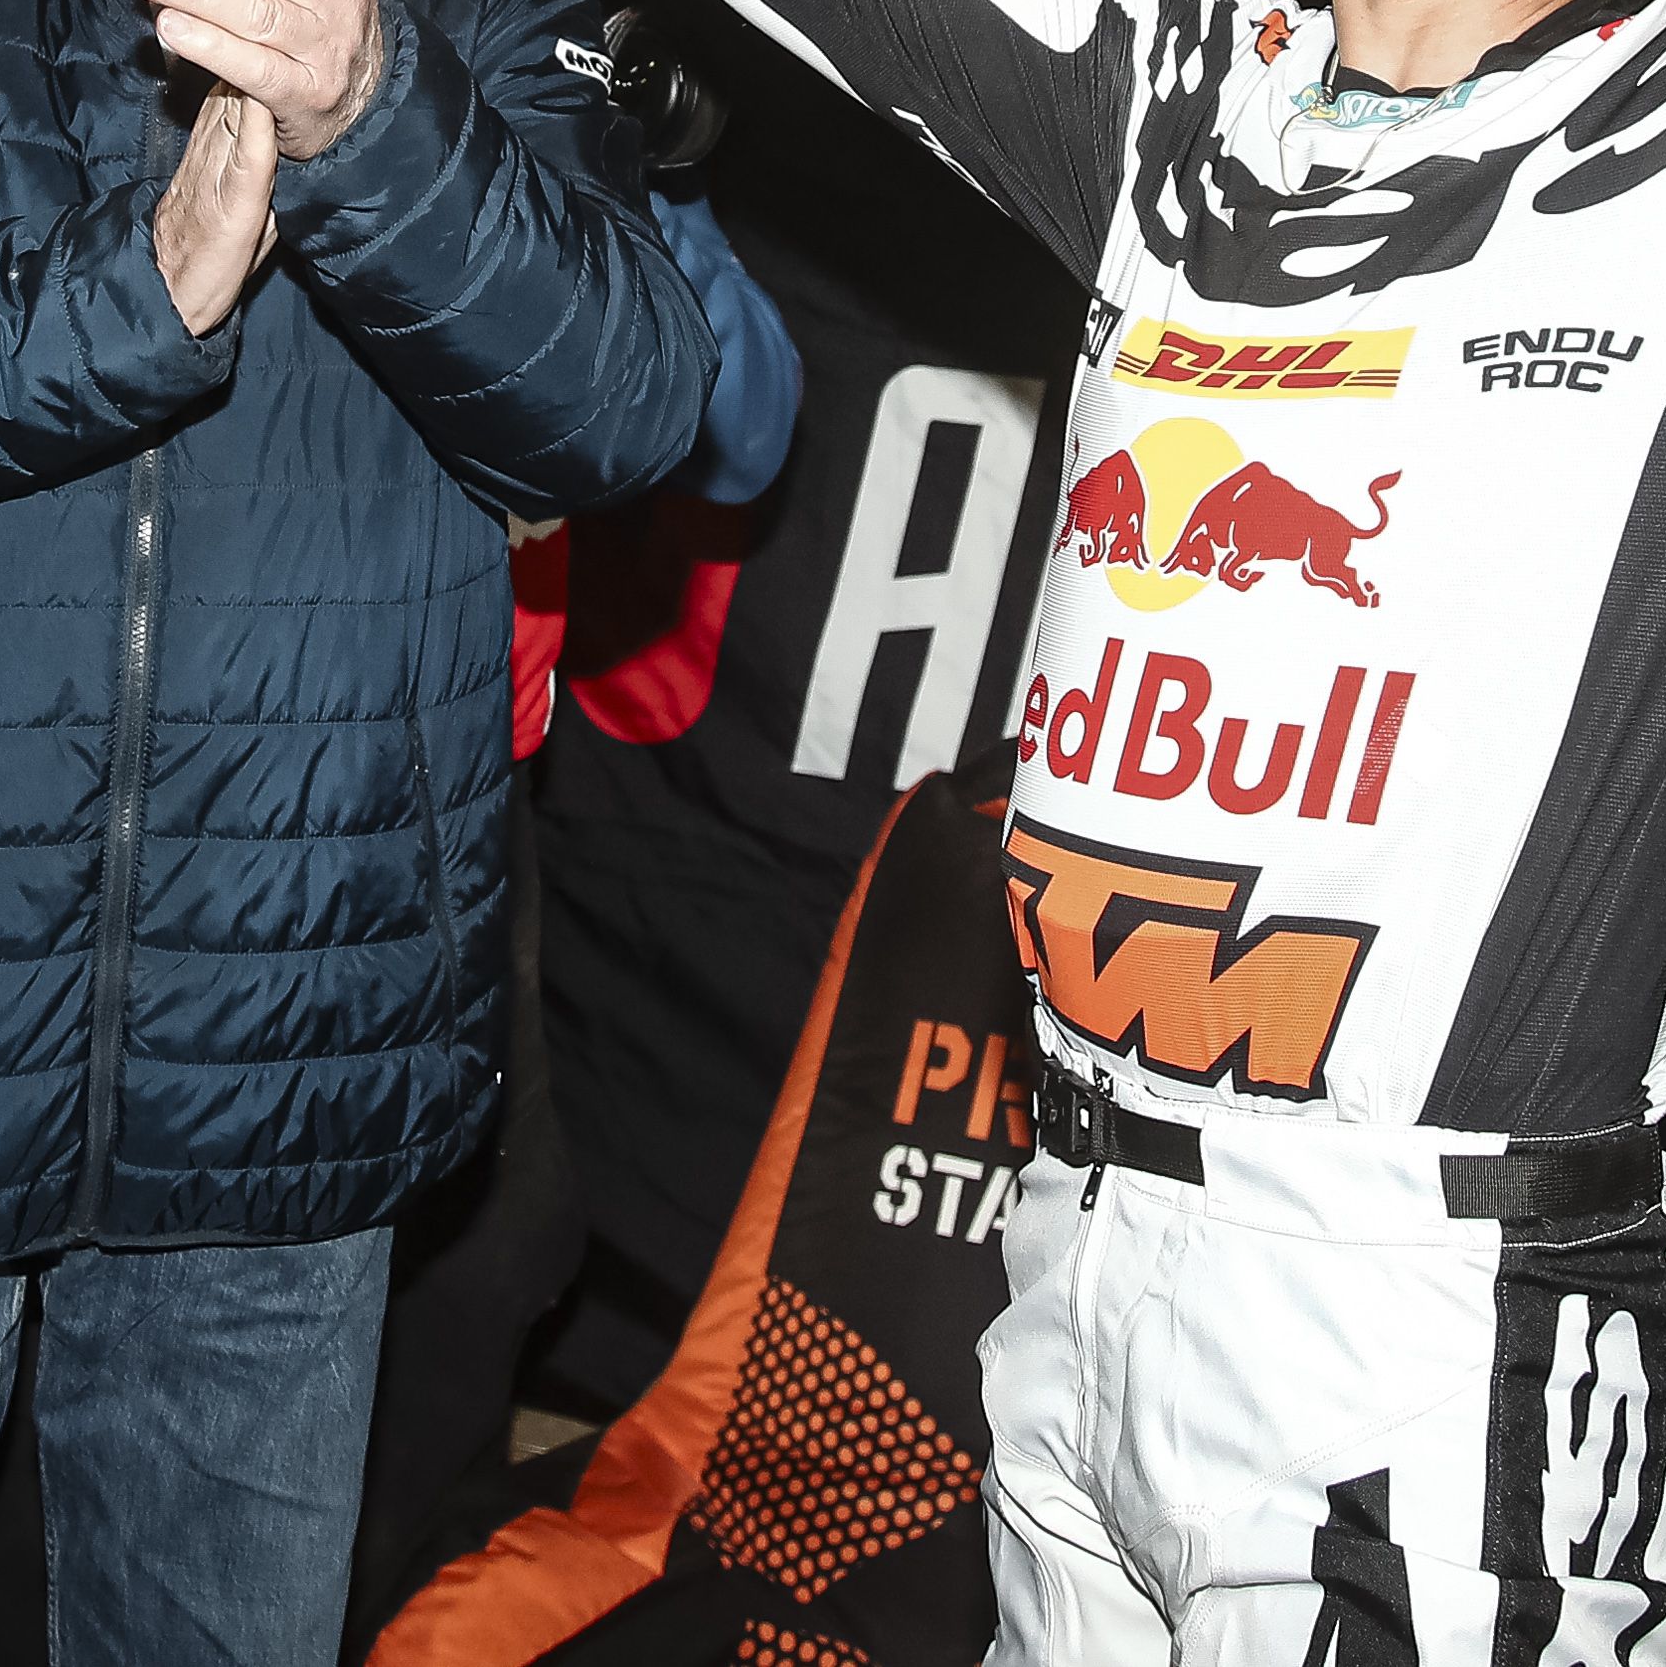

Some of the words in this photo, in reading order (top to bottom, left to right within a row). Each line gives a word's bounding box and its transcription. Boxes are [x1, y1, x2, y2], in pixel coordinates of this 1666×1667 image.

[1336, 85, 1471, 127] MOTOX
[1139, 329, 1354, 390] DHL
[1463, 328, 1645, 364] ENDU
[1481, 359, 1612, 393] ROC
[1017, 637, 1125, 787] ed
[1112, 651, 1418, 827] Bull
